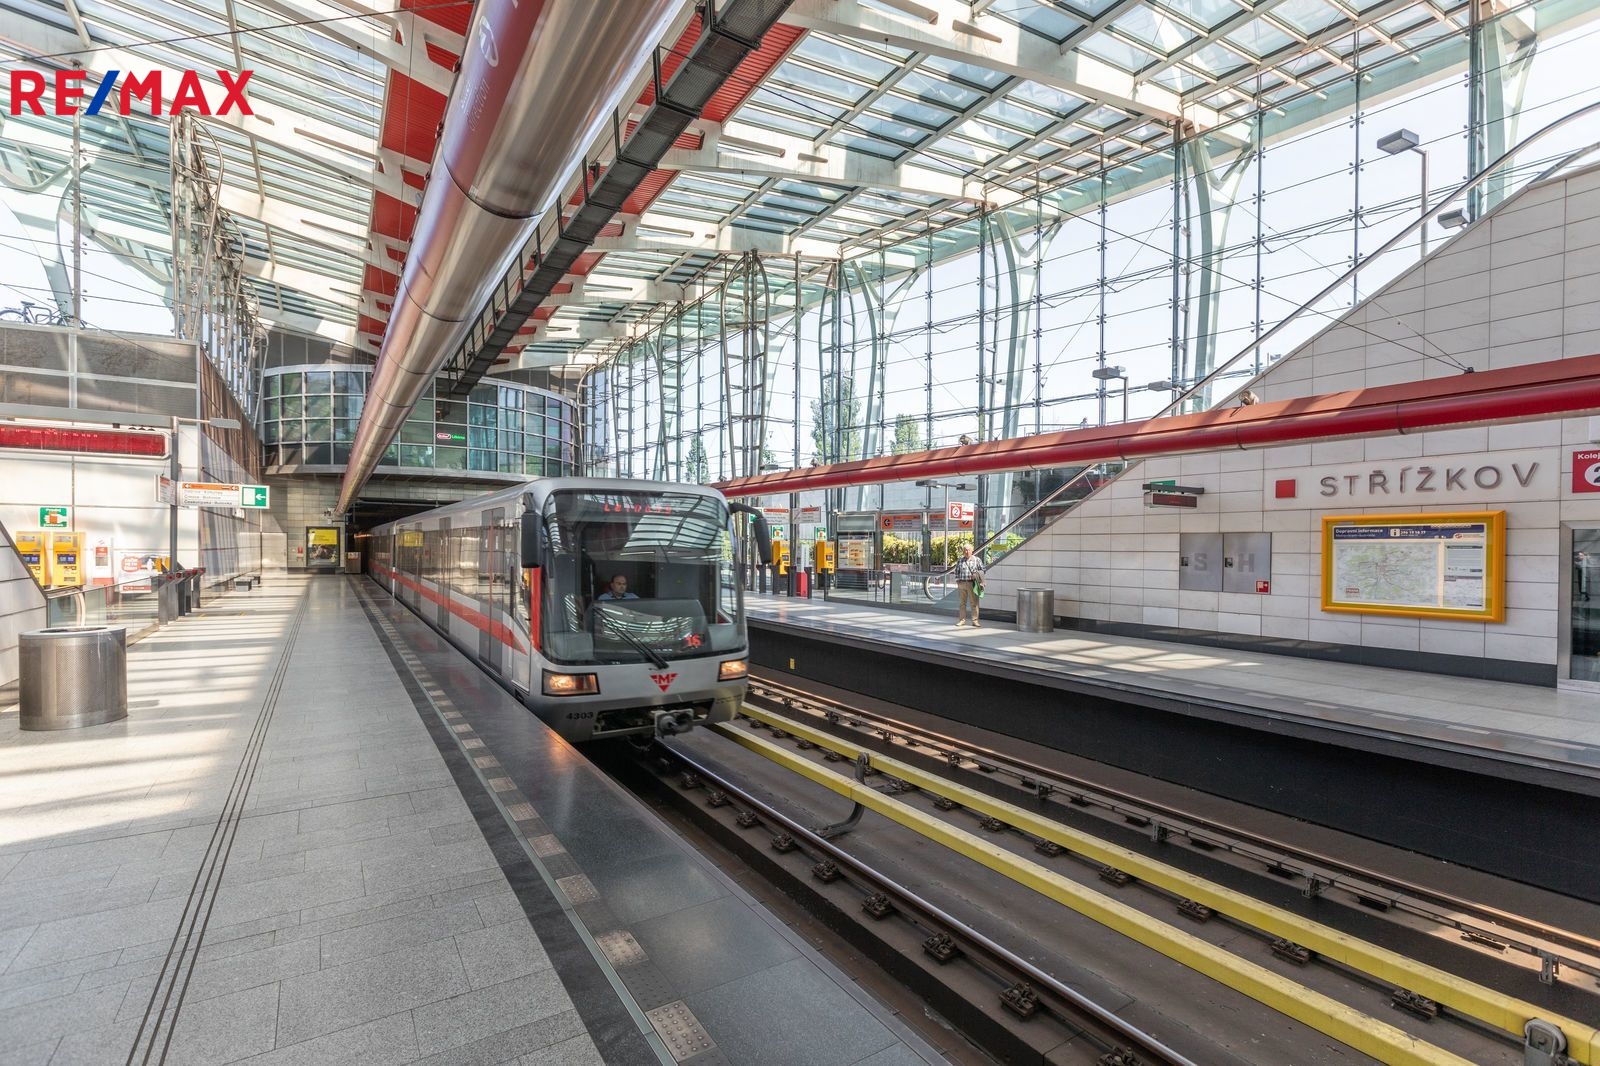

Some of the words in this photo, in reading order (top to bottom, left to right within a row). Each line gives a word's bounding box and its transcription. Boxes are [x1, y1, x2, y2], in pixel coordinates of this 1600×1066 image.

[1319, 461, 1540, 498] STŘÍŽKOV
[1194, 552, 1207, 571] S
[1238, 553, 1255, 573] H
[566, 711, 594, 720] 4303
